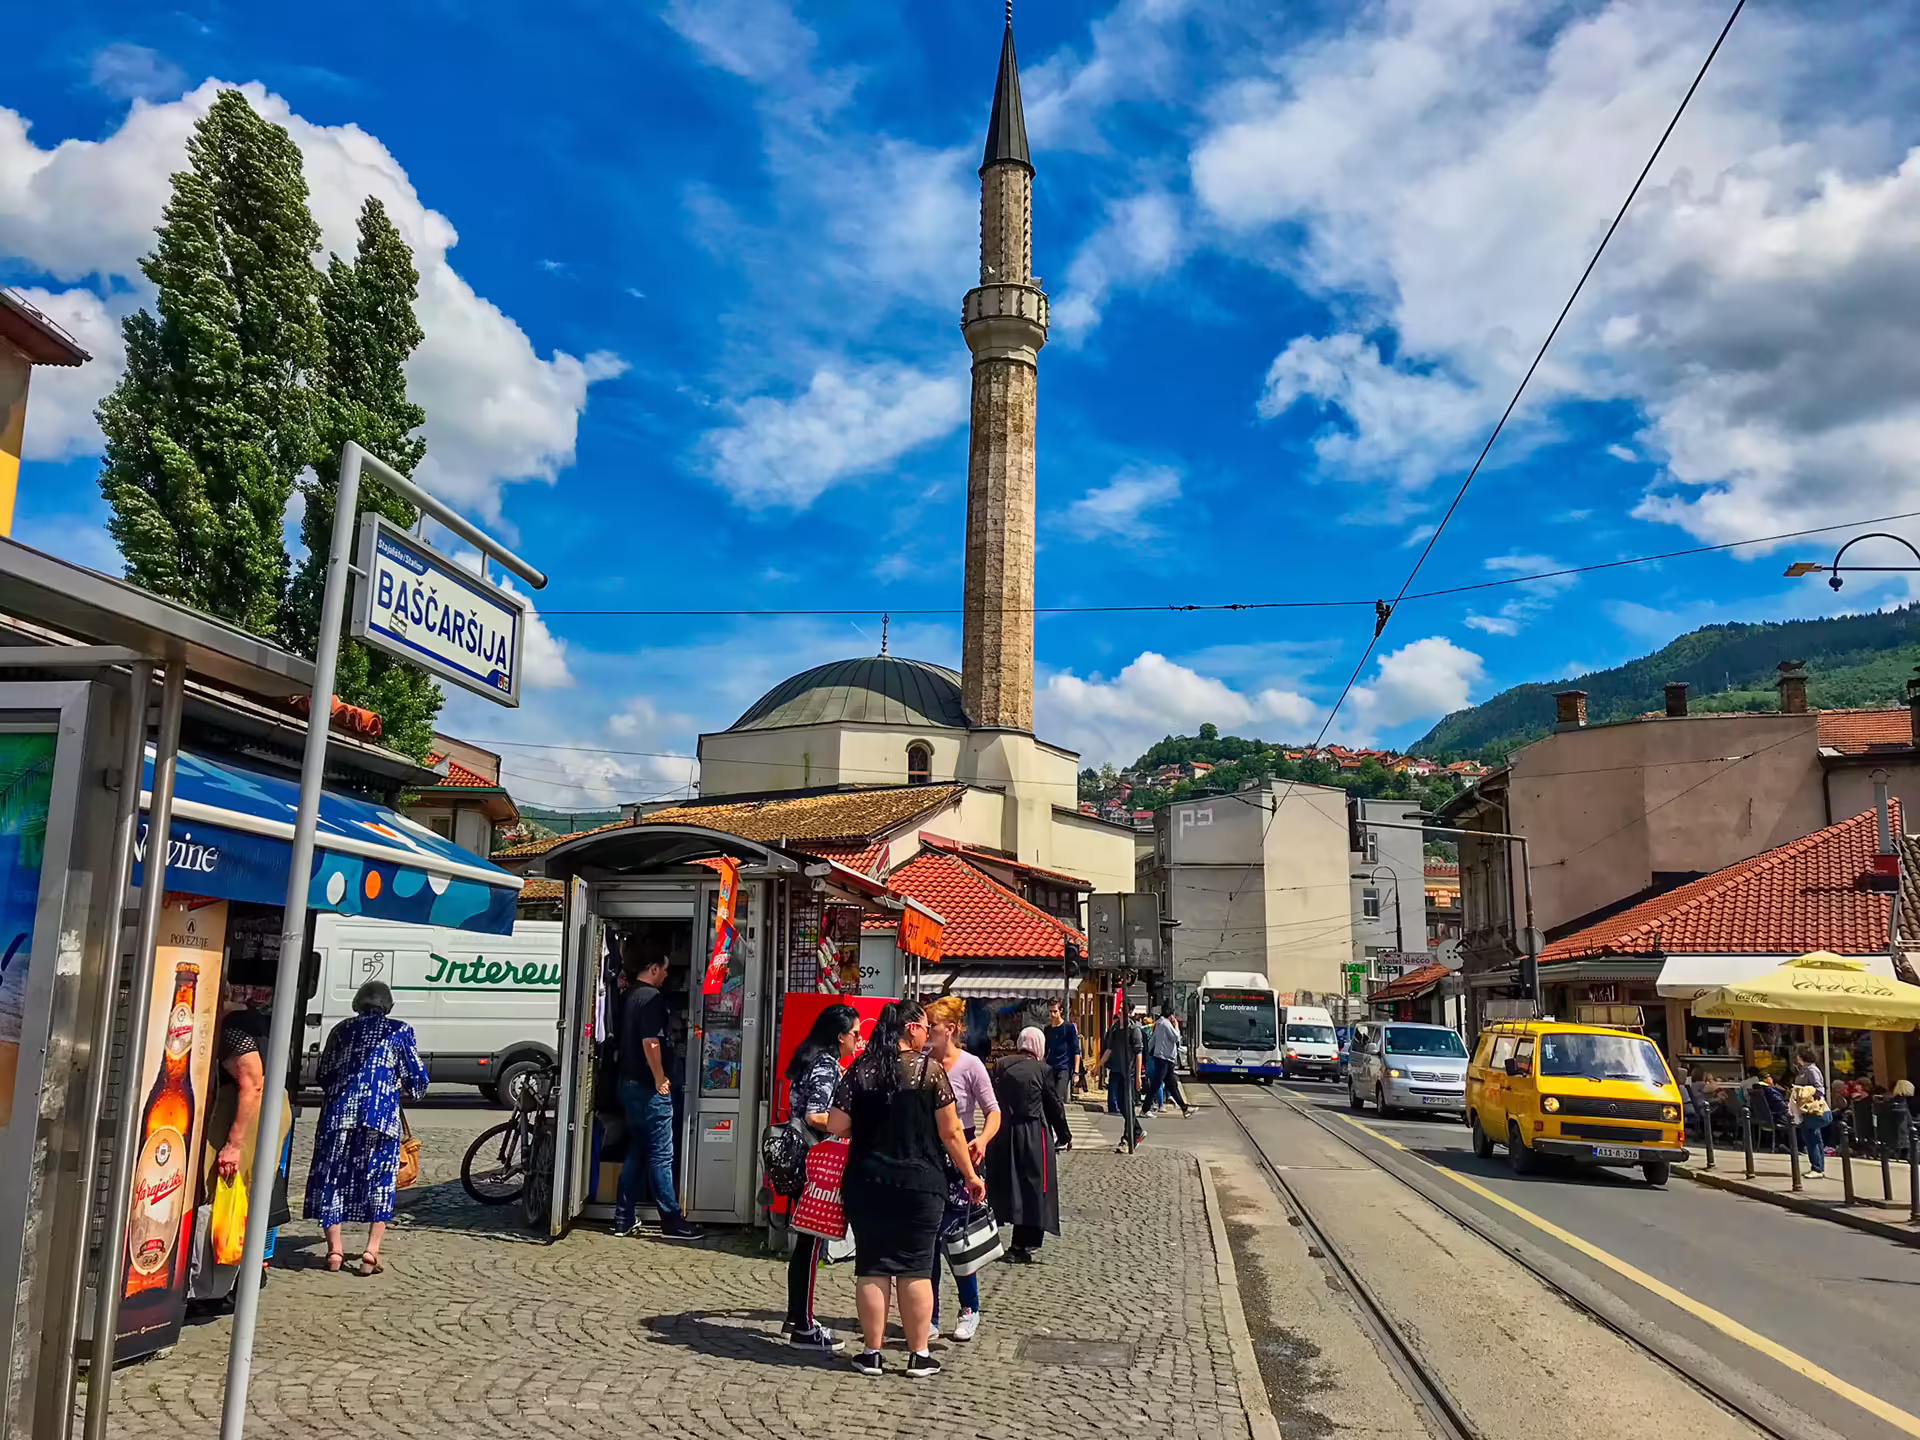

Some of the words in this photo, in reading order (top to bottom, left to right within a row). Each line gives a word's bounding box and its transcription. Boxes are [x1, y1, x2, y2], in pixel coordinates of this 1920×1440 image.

[377, 568, 507, 670] BAŠČARŠIJA
[134, 823, 221, 873] Nvine
[1219, 1003, 1259, 1012] Centrotrans
